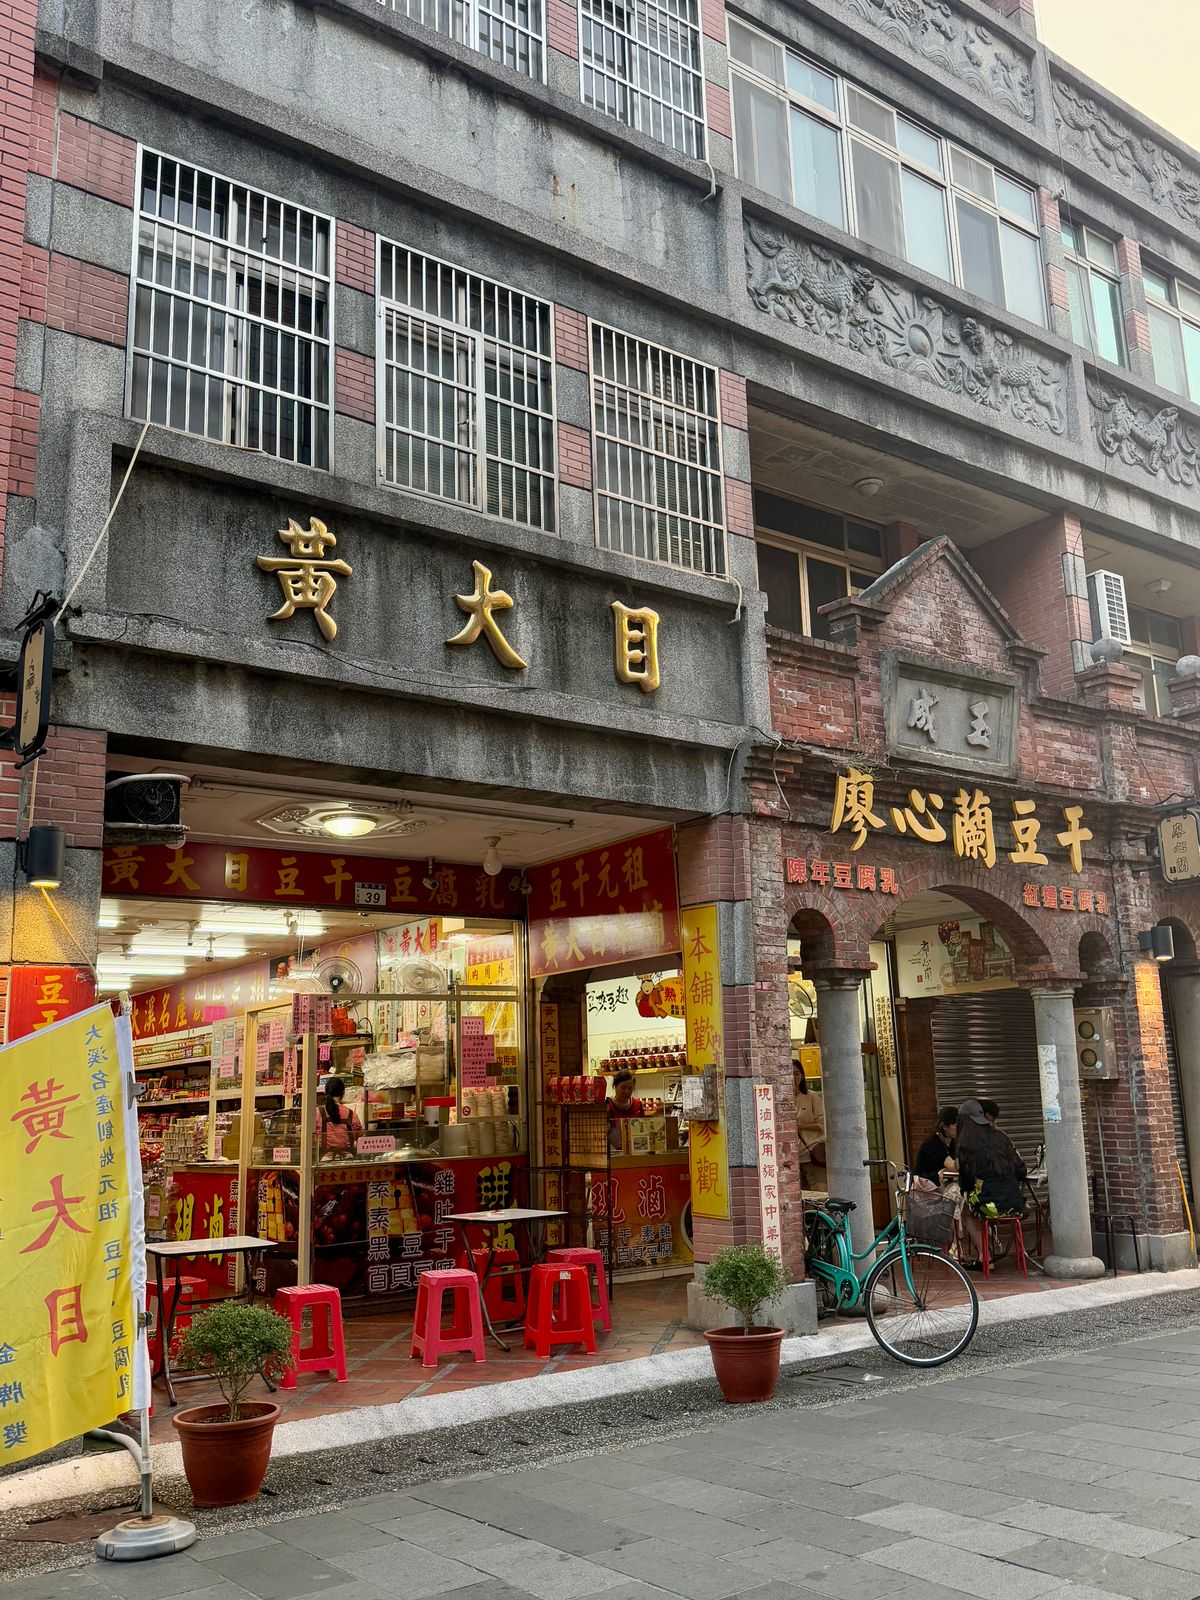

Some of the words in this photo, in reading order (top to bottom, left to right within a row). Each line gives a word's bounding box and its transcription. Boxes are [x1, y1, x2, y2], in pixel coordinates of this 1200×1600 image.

[256, 516, 660, 692] 黃大目
[831, 767, 1093, 874] 廖心蘭豆干
[364, 892, 381, 904] 39
[786, 857, 900, 895] 陳年豆腐乳
